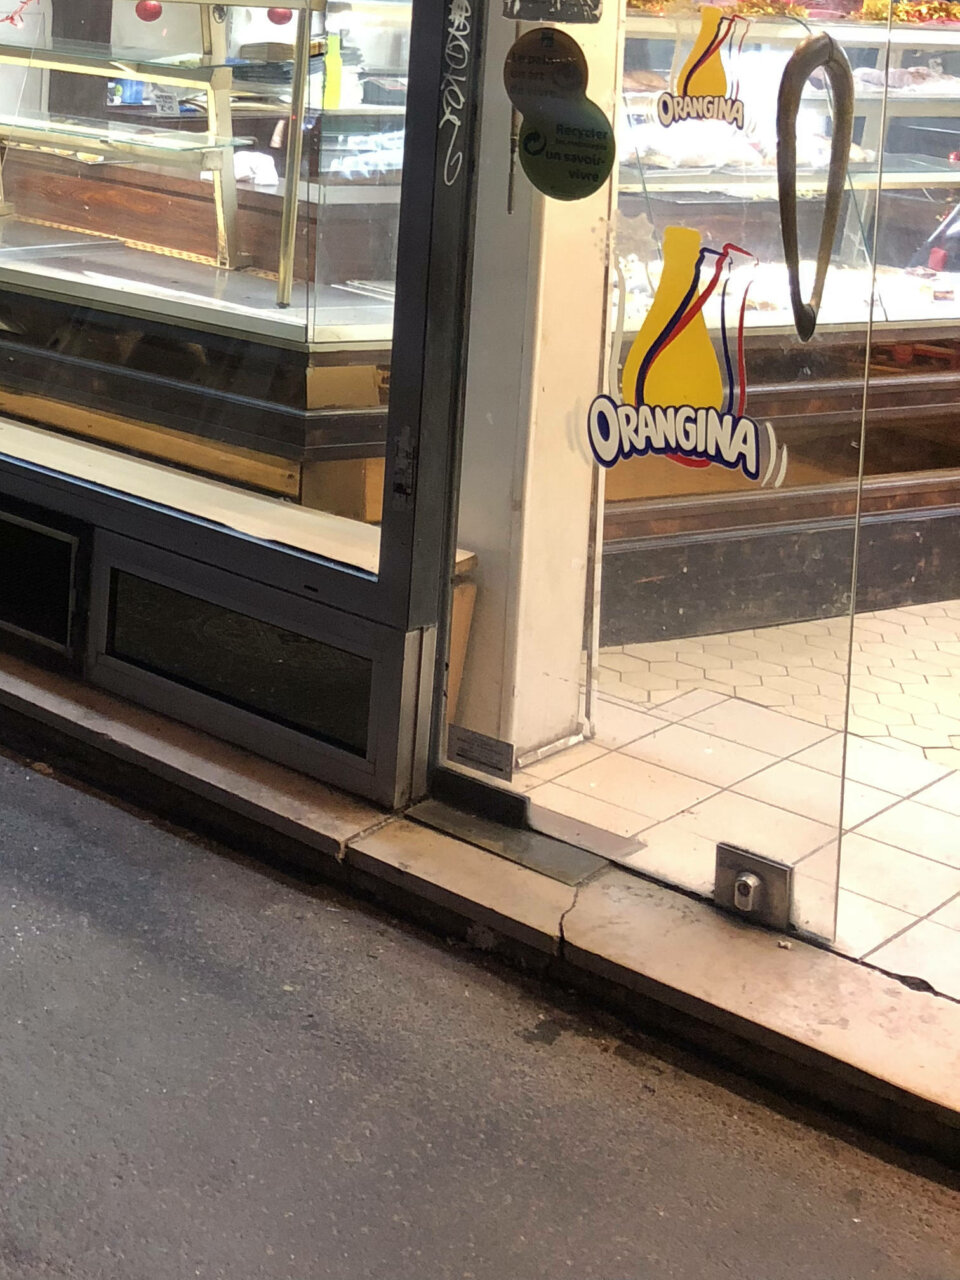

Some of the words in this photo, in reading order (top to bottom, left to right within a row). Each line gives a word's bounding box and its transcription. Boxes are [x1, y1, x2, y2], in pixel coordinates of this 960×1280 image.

[657, 91, 744, 130] ORANGINA
[545, 151, 562, 162] un
[588, 394, 760, 481] ORANGINA
